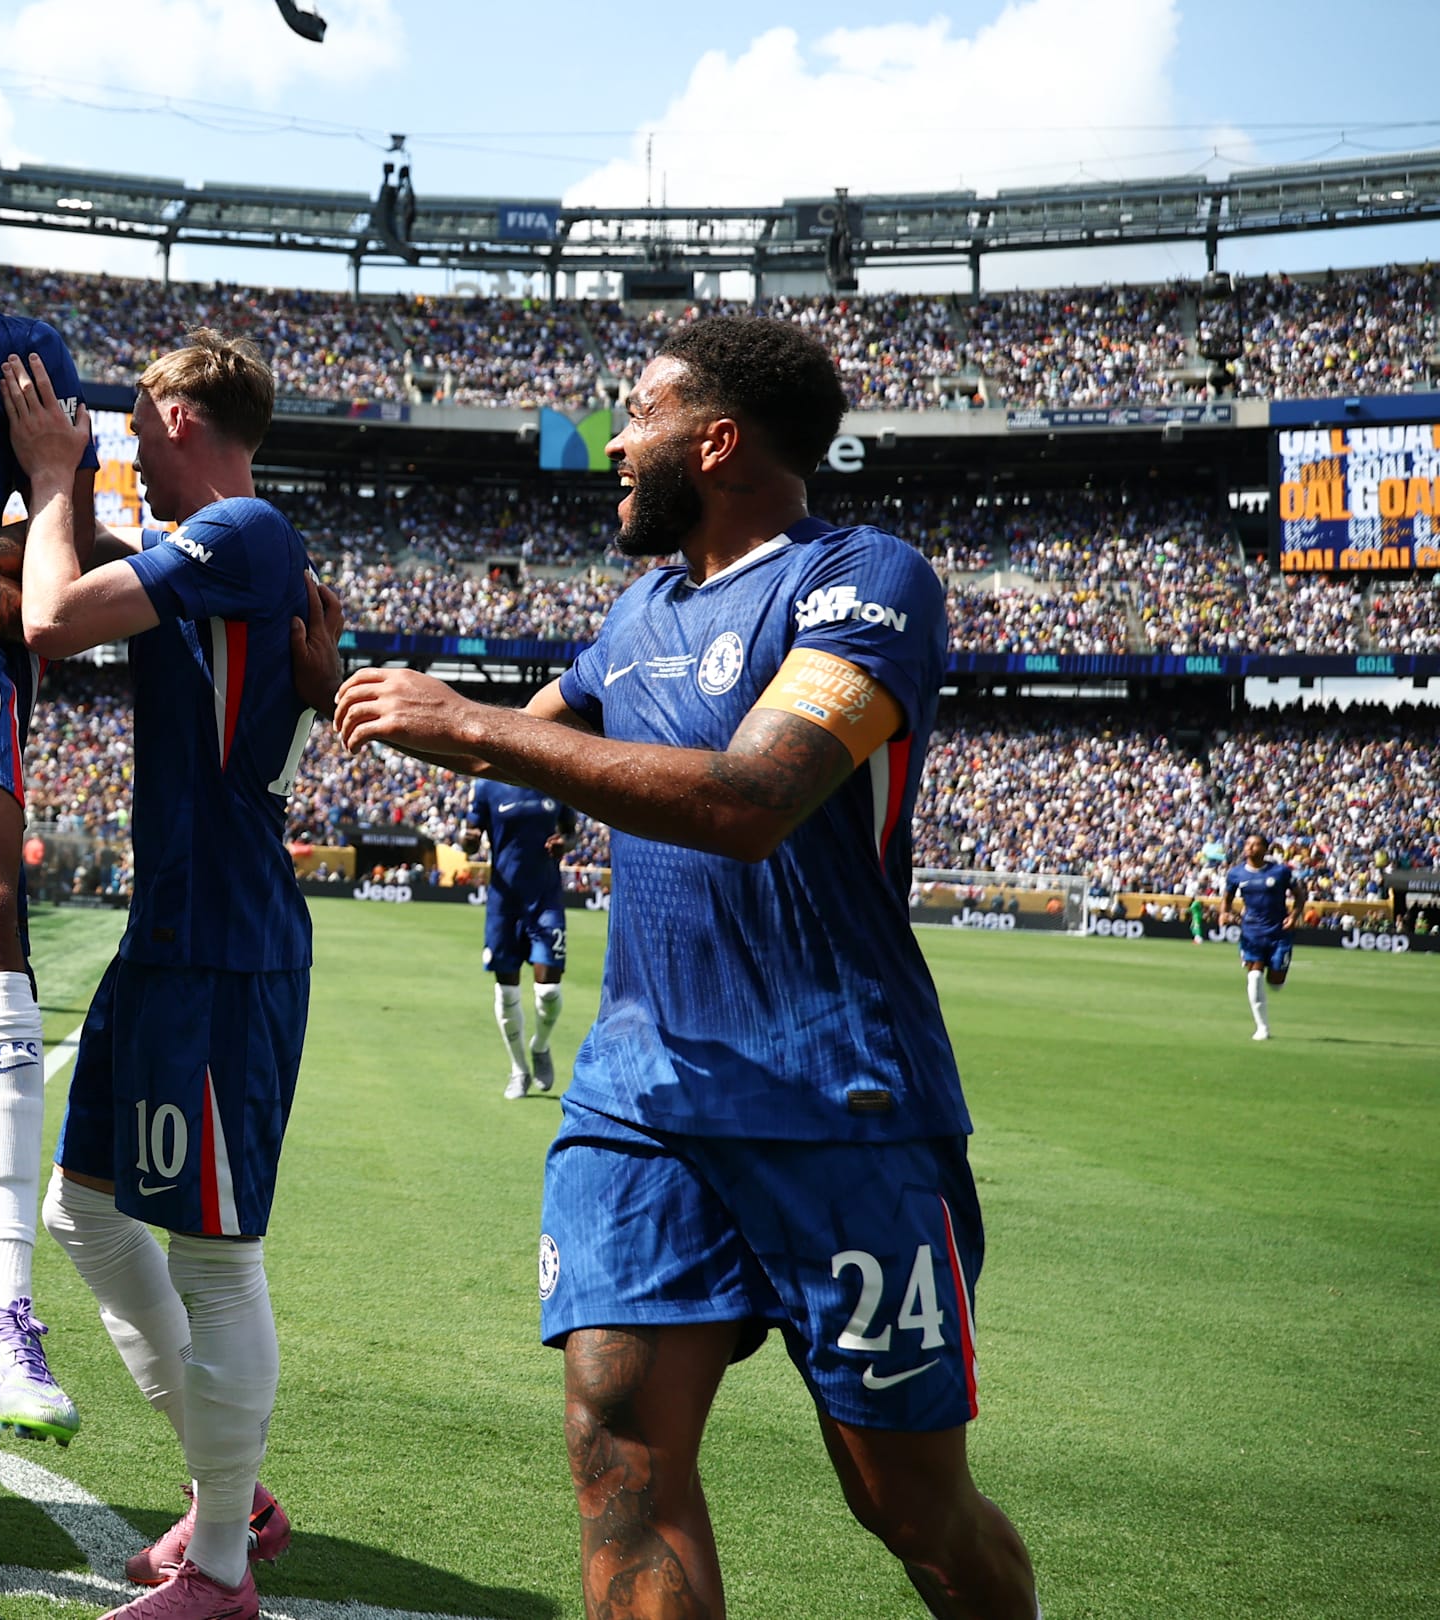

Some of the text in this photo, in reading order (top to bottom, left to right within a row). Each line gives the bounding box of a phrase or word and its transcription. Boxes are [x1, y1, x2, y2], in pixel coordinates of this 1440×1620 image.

[506, 211, 549, 229] FIFA
[795, 600, 908, 632] NATION
[805, 653, 878, 697] FOOTBALL
[1025, 655, 1059, 673] GOAL
[1185, 655, 1222, 673] GOAL
[1356, 655, 1395, 674] GOAL
[795, 666, 872, 709] UNITES
[796, 700, 827, 719] FIFA
[354, 880, 412, 903] Jeep
[952, 906, 1017, 931] Jeep
[1090, 914, 1145, 938] Jeep
[1341, 927, 1410, 953] Jeep
[136, 1100, 188, 1178] 10
[832, 1244, 946, 1352] 24
